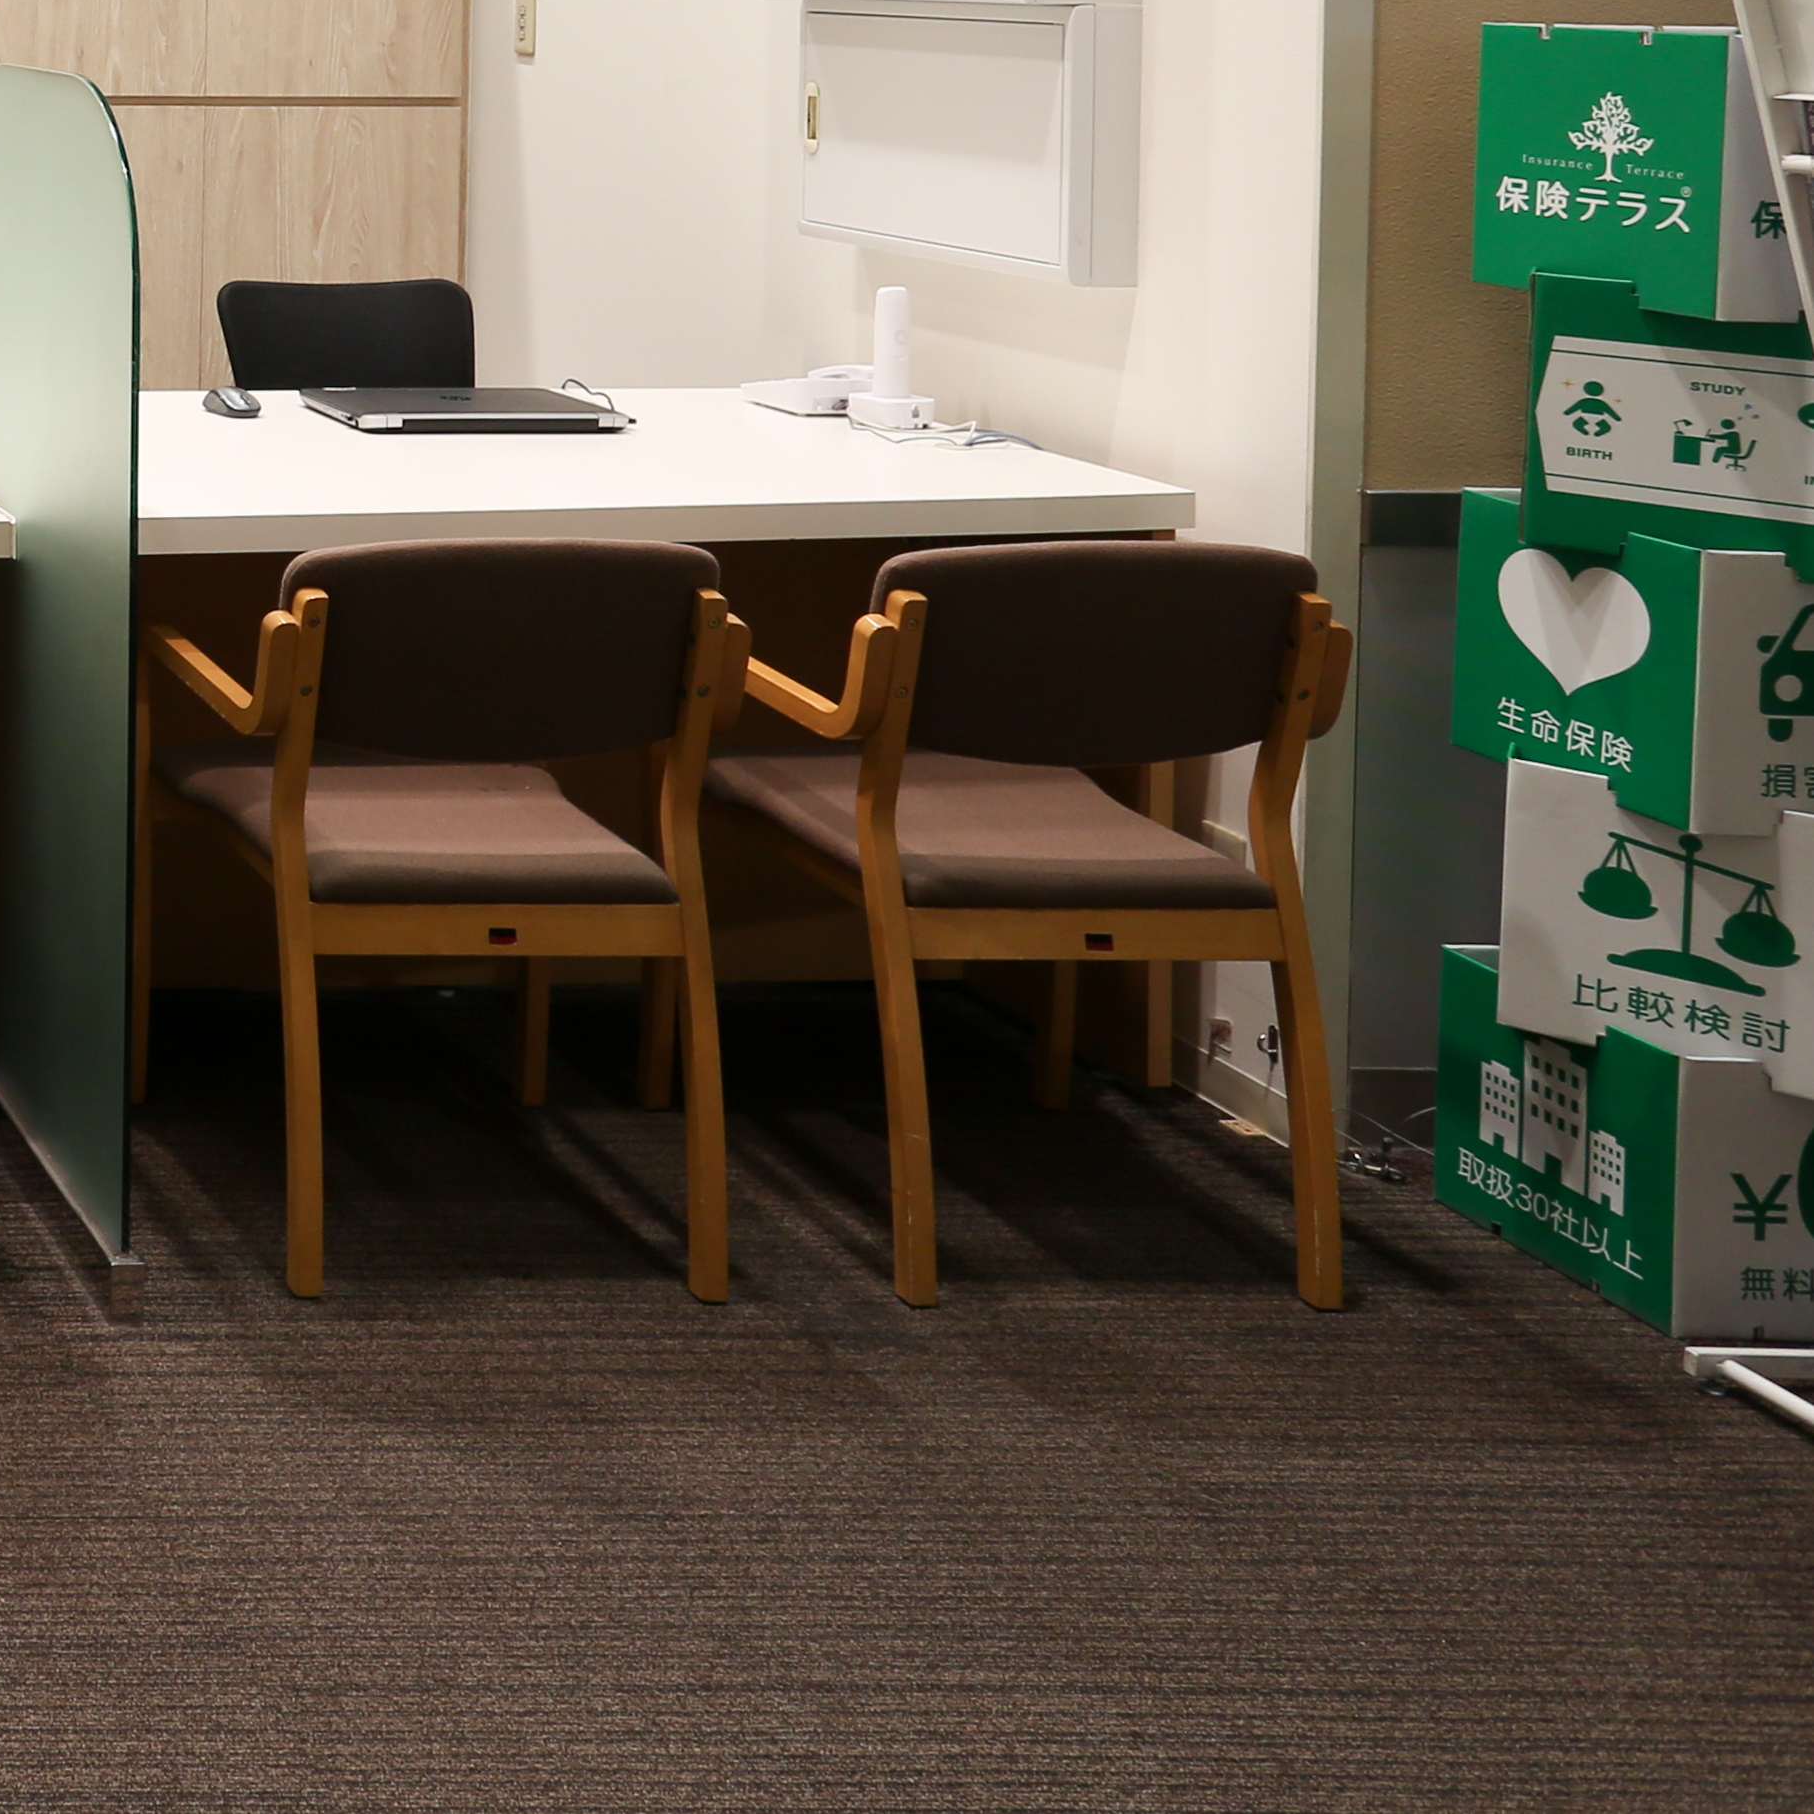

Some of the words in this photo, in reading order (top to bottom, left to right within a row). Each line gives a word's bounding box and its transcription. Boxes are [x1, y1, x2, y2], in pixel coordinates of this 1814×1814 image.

[1522, 153, 1594, 171] Insurance
[1625, 163, 1685, 180] Terrace
[1689, 381, 1746, 396] STUDY
[1566, 446, 1613, 461] BIRTH
[1496, 696, 1634, 773] 生命保険
[1571, 974, 1790, 1053] 比較検討
[1457, 1146, 1644, 1281] 取扱30社以上
